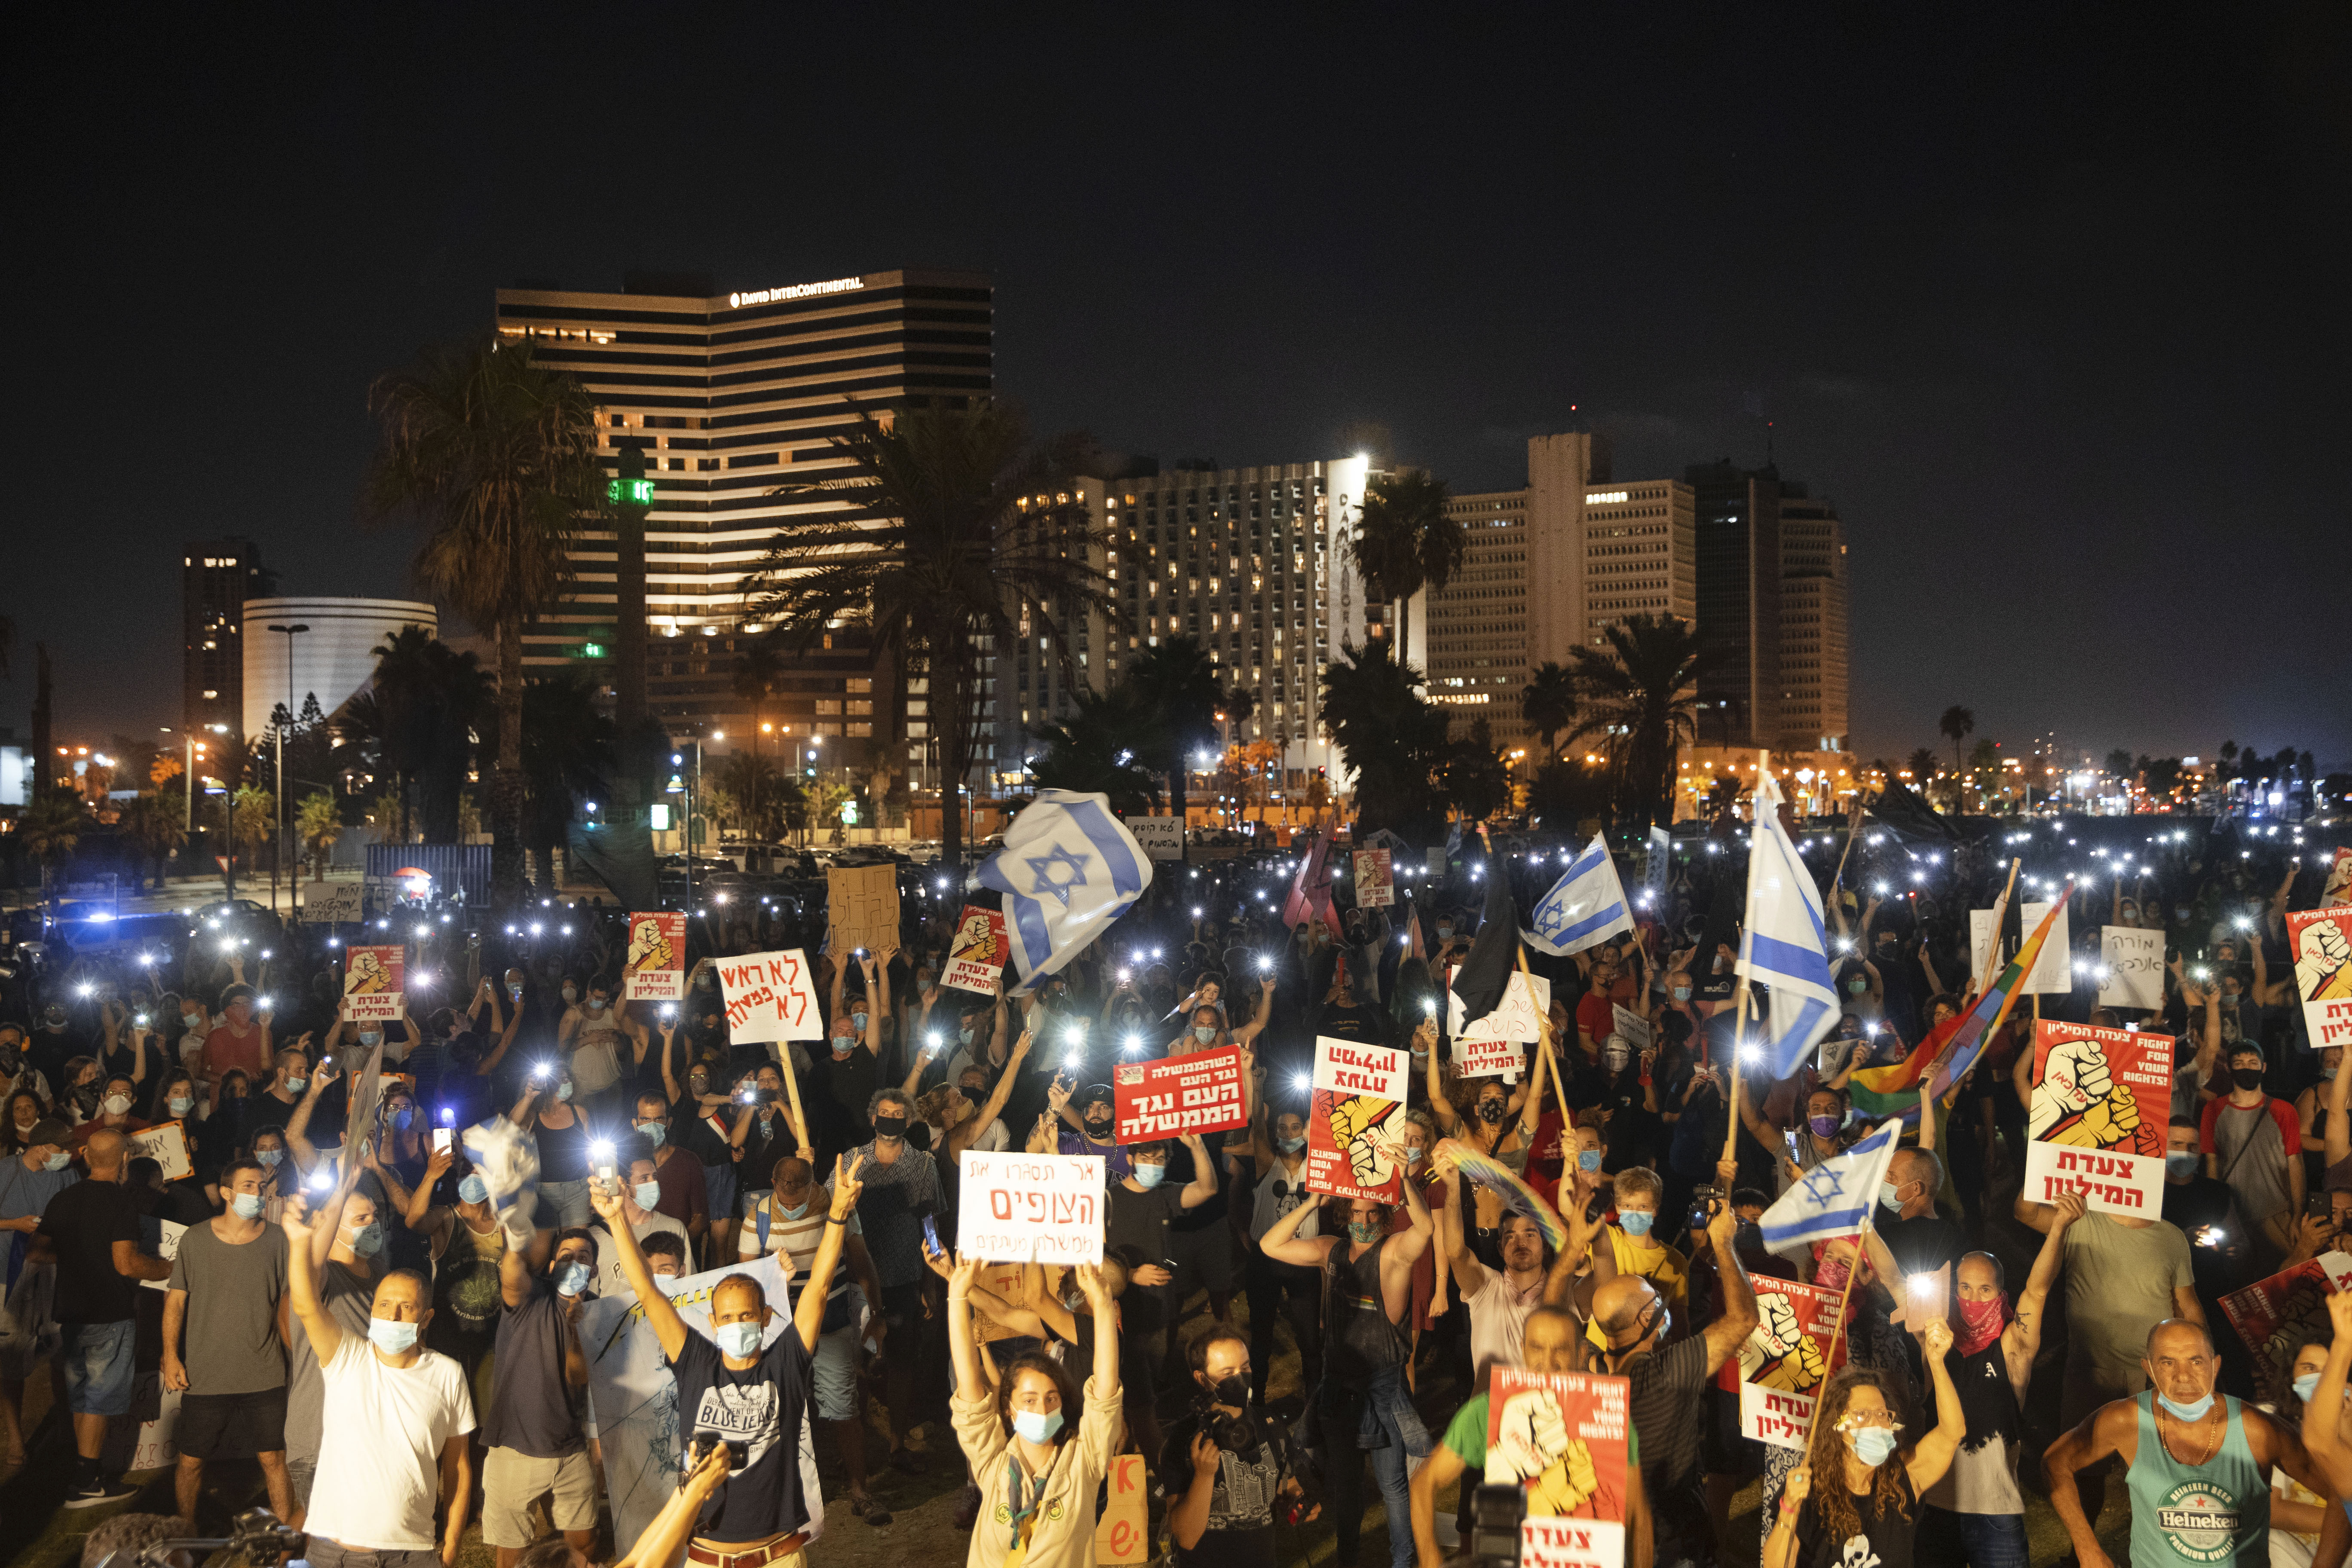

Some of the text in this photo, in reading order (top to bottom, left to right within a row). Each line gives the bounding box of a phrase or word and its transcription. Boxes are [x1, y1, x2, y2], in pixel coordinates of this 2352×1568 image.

[1160, 820, 1175, 832] לא
[2293, 911, 2326, 923] המיליון
[2306, 947, 2322, 959] כאן
[2324, 955, 2336, 966] עד
[721, 955, 799, 988] לא ראש
[957, 962, 989, 976] צעדת
[640, 974, 671, 982] צעדת
[948, 973, 990, 989] המיליון
[634, 984, 675, 998] המיליון
[357, 996, 390, 1004] צעדת
[724, 986, 807, 1029] לא ממשלה
[352, 1006, 395, 1019] המיליון
[2047, 1022, 2131, 1042] צעדת המיליון
[1468, 1040, 1507, 1055] צעדת
[2137, 1038, 2171, 1050] FIGHT
[1329, 1046, 1396, 1074] המיליון
[2146, 1050, 2170, 1063] FOR
[1152, 1054, 1236, 1078] כשהממשלה
[1463, 1056, 1515, 1075] המיליון
[2138, 1061, 2169, 1074] YOUR
[1180, 1068, 1237, 1086] נגד העם
[1335, 1070, 1387, 1093] צעדת
[2051, 1071, 2073, 1089] כאן
[2123, 1072, 2168, 1086] RIGHTS!
[1131, 1082, 1239, 1114] העם נגד
[2073, 1087, 2090, 1103] עד
[1122, 1102, 1241, 1136] הממשלה
[1311, 1148, 1341, 1161] RIGHTS!
[970, 1161, 989, 1177] את
[1007, 1163, 1054, 1180] תסגרו
[1070, 1159, 1093, 1180] אל
[1310, 1159, 1332, 1170] YOUR
[2057, 1151, 2134, 1179] צעדת
[1310, 1169, 1325, 1179] FOR
[1309, 1179, 1332, 1190] FIGHT
[2044, 1174, 2143, 1208] המיליון
[1336, 1185, 1393, 1203] צעדת המיליון
[990, 1188, 1094, 1225] הצופים
[1035, 1233, 1093, 1253] ממשלת
[1750, 1274, 1810, 1296] צעדת המיליו
[1815, 1292, 1841, 1304] FIGHT
[2252, 1286, 2277, 1320] RIGHTS!
[1758, 1323, 1771, 1336] כא
[1808, 1323, 1843, 1337] RIGHT!
[1592, 1381, 1625, 1397] FIGHT
[707, 1397, 744, 1415] DEPARENT
[1602, 1397, 1625, 1412] FOR
[1765, 1393, 1813, 1418] עדת
[701, 1405, 740, 1429] BLUE
[1592, 1408, 1624, 1426] YOUR
[2170, 1483, 2232, 1504] HEINEKEN BEER
[2162, 1512, 2238, 1528] Heineken
[2169, 1535, 2235, 1561] PREMIUM QUALITY
